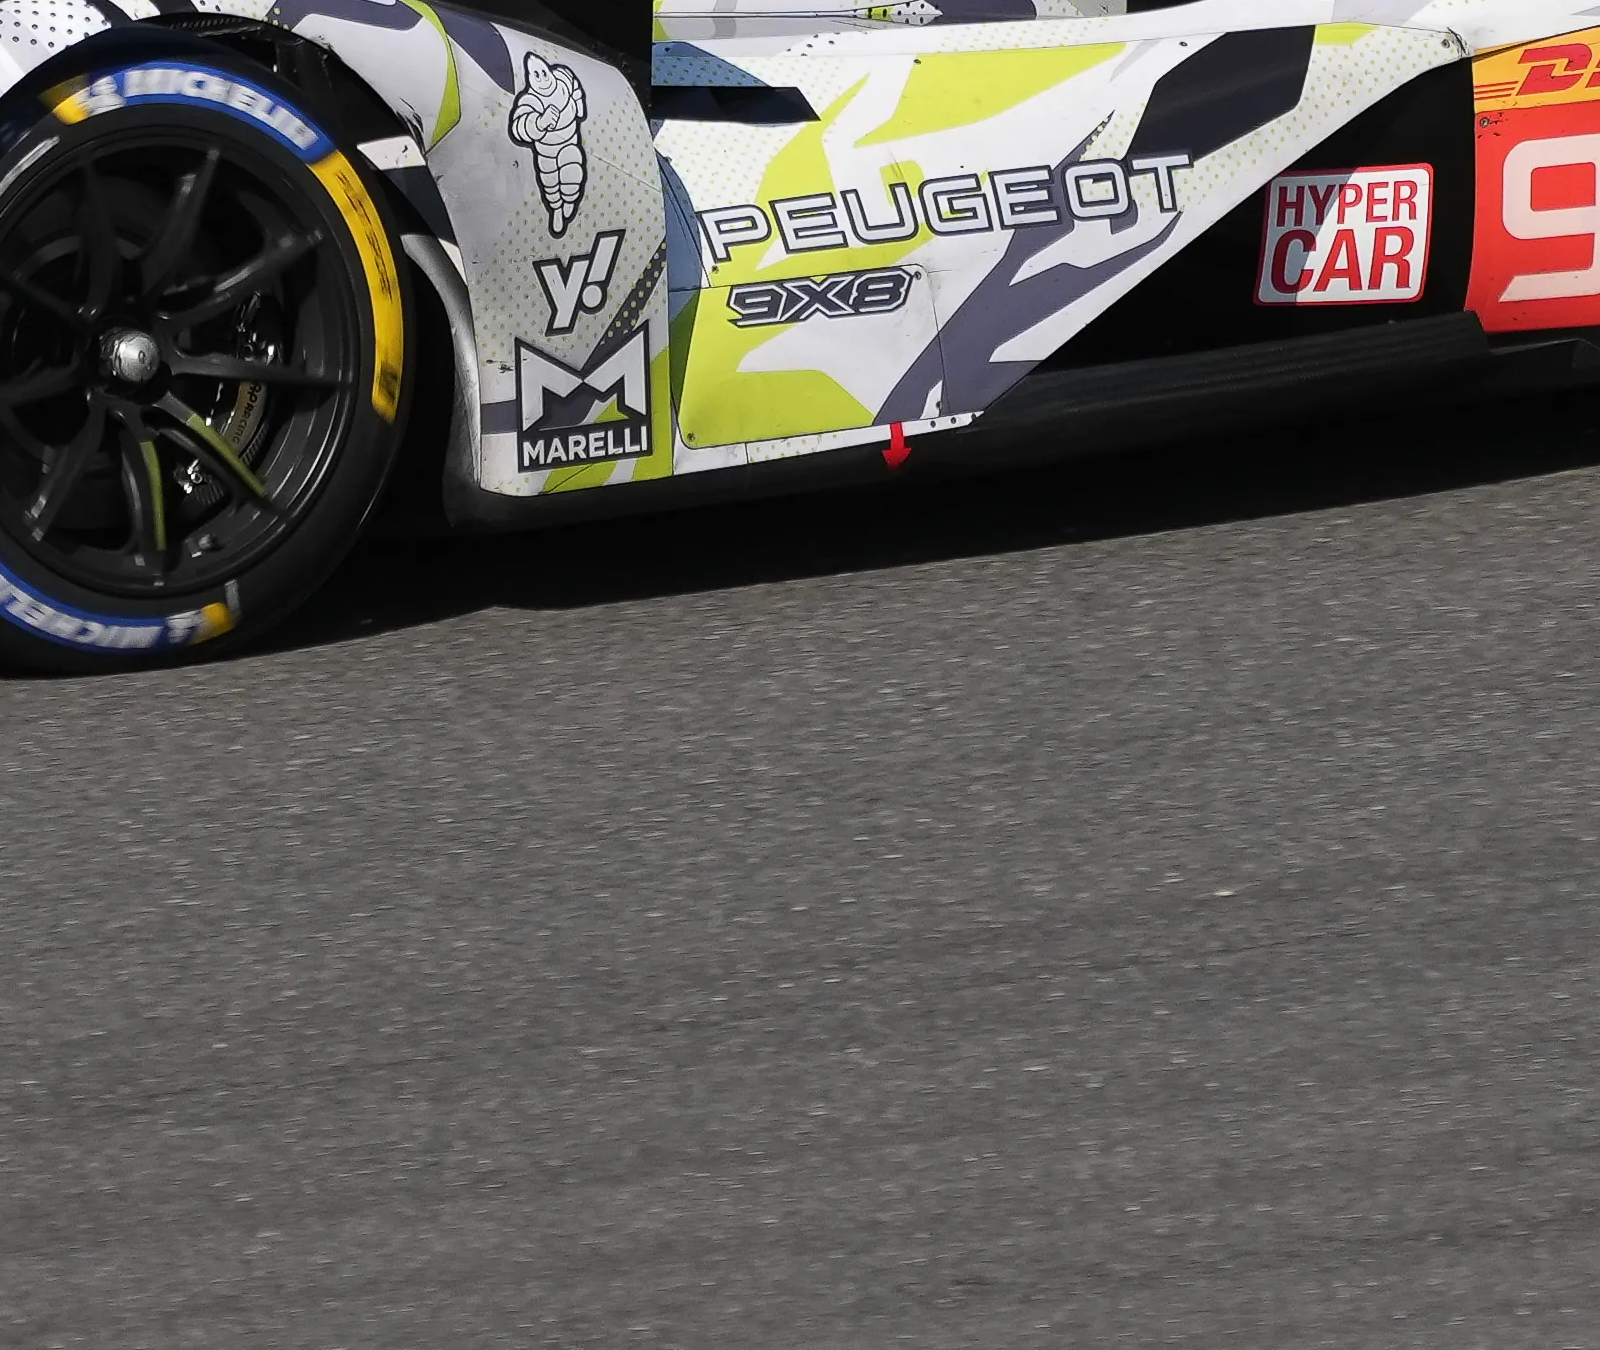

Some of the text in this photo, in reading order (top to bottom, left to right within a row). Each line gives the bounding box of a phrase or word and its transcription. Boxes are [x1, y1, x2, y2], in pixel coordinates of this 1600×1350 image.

[698, 155, 1194, 263] PEUGEOT
[1276, 180, 1419, 230] HYPER
[1270, 225, 1416, 295] CAR
[728, 266, 914, 327] 9X8
[522, 425, 648, 467] MARELLI
